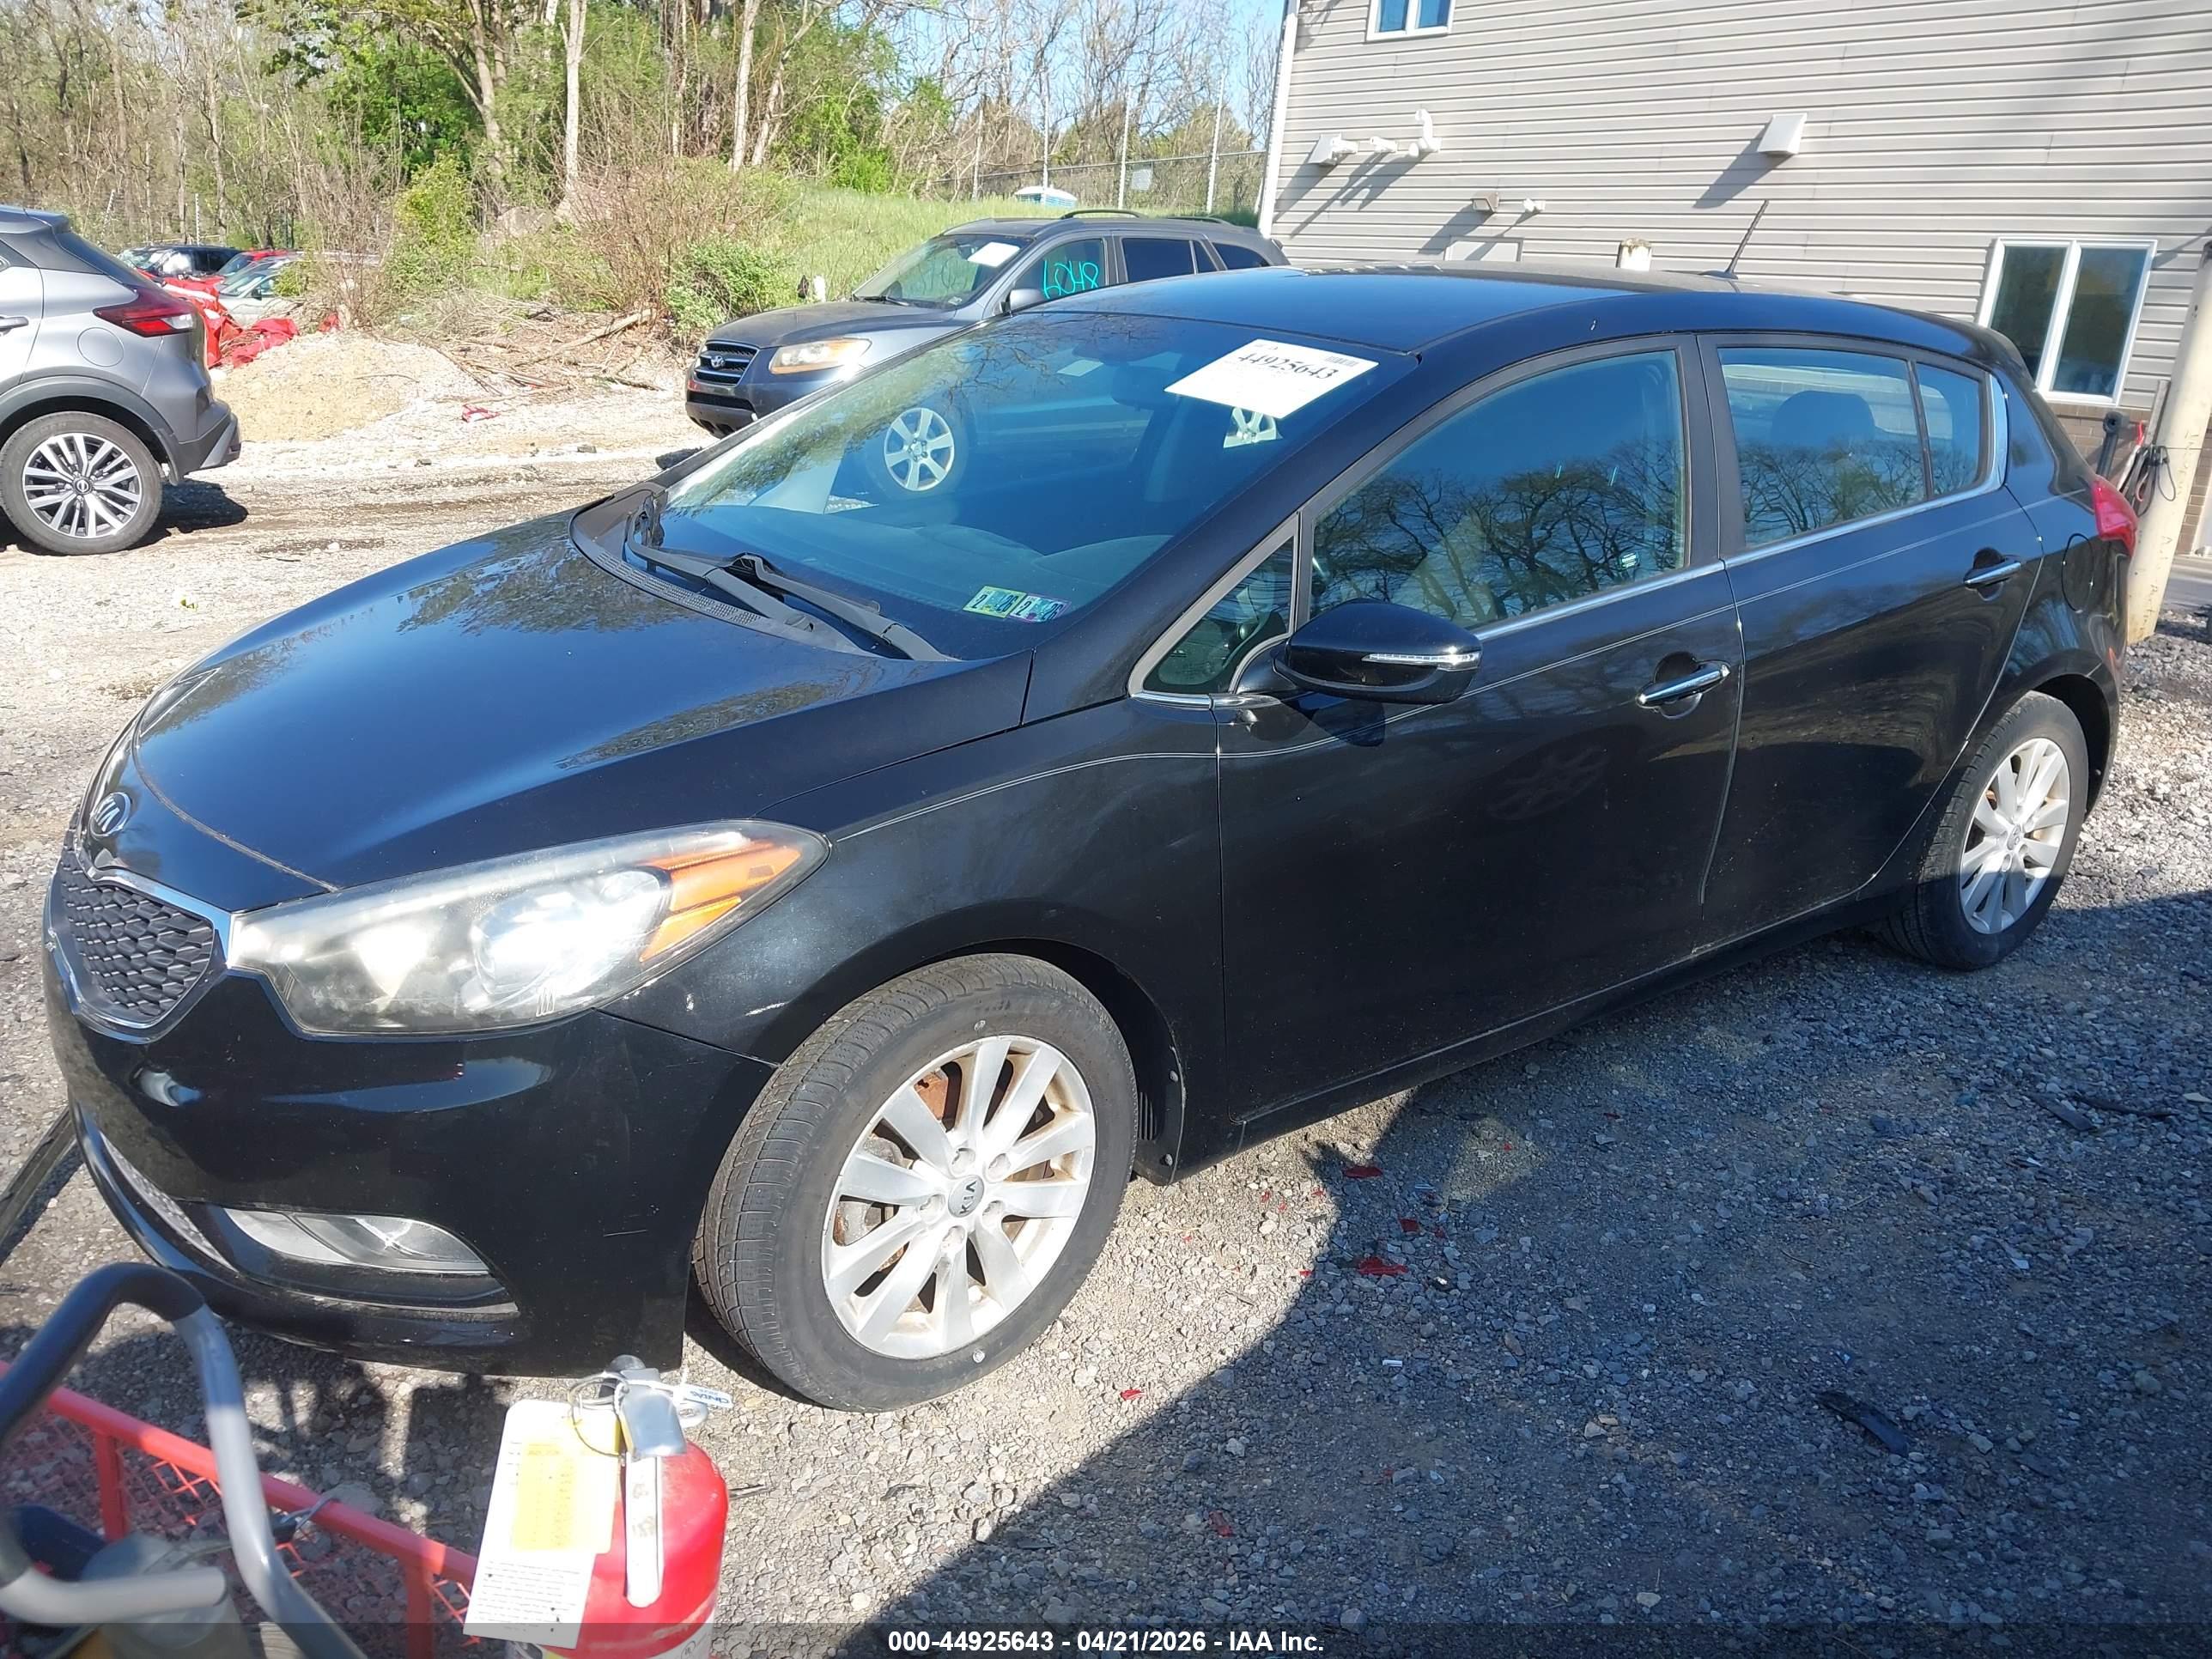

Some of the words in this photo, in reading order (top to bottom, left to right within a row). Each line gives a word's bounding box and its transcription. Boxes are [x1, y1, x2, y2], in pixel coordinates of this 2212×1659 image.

[1238, 352, 1339, 379] 44925643
[971, 594, 988, 609] 2
[1016, 600, 1032, 616] 2
[959, 1181, 977, 1214] KIA
